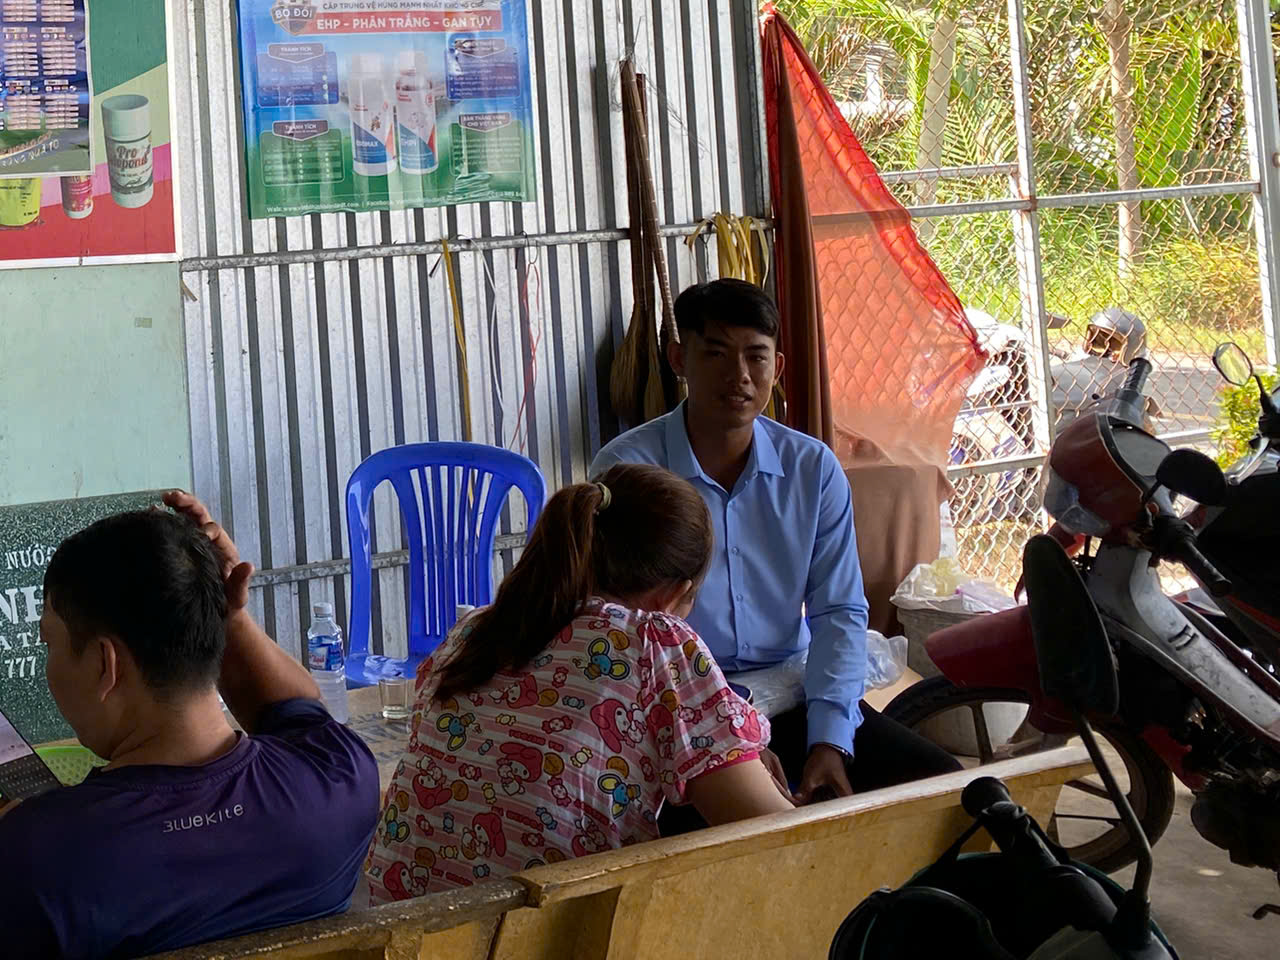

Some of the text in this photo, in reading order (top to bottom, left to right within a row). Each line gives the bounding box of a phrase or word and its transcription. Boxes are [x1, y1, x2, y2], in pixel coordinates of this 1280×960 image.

[317, 12, 492, 30] EHP PHÂN TRẮNG GAN TỤY
[4, 655, 37, 678] 777
